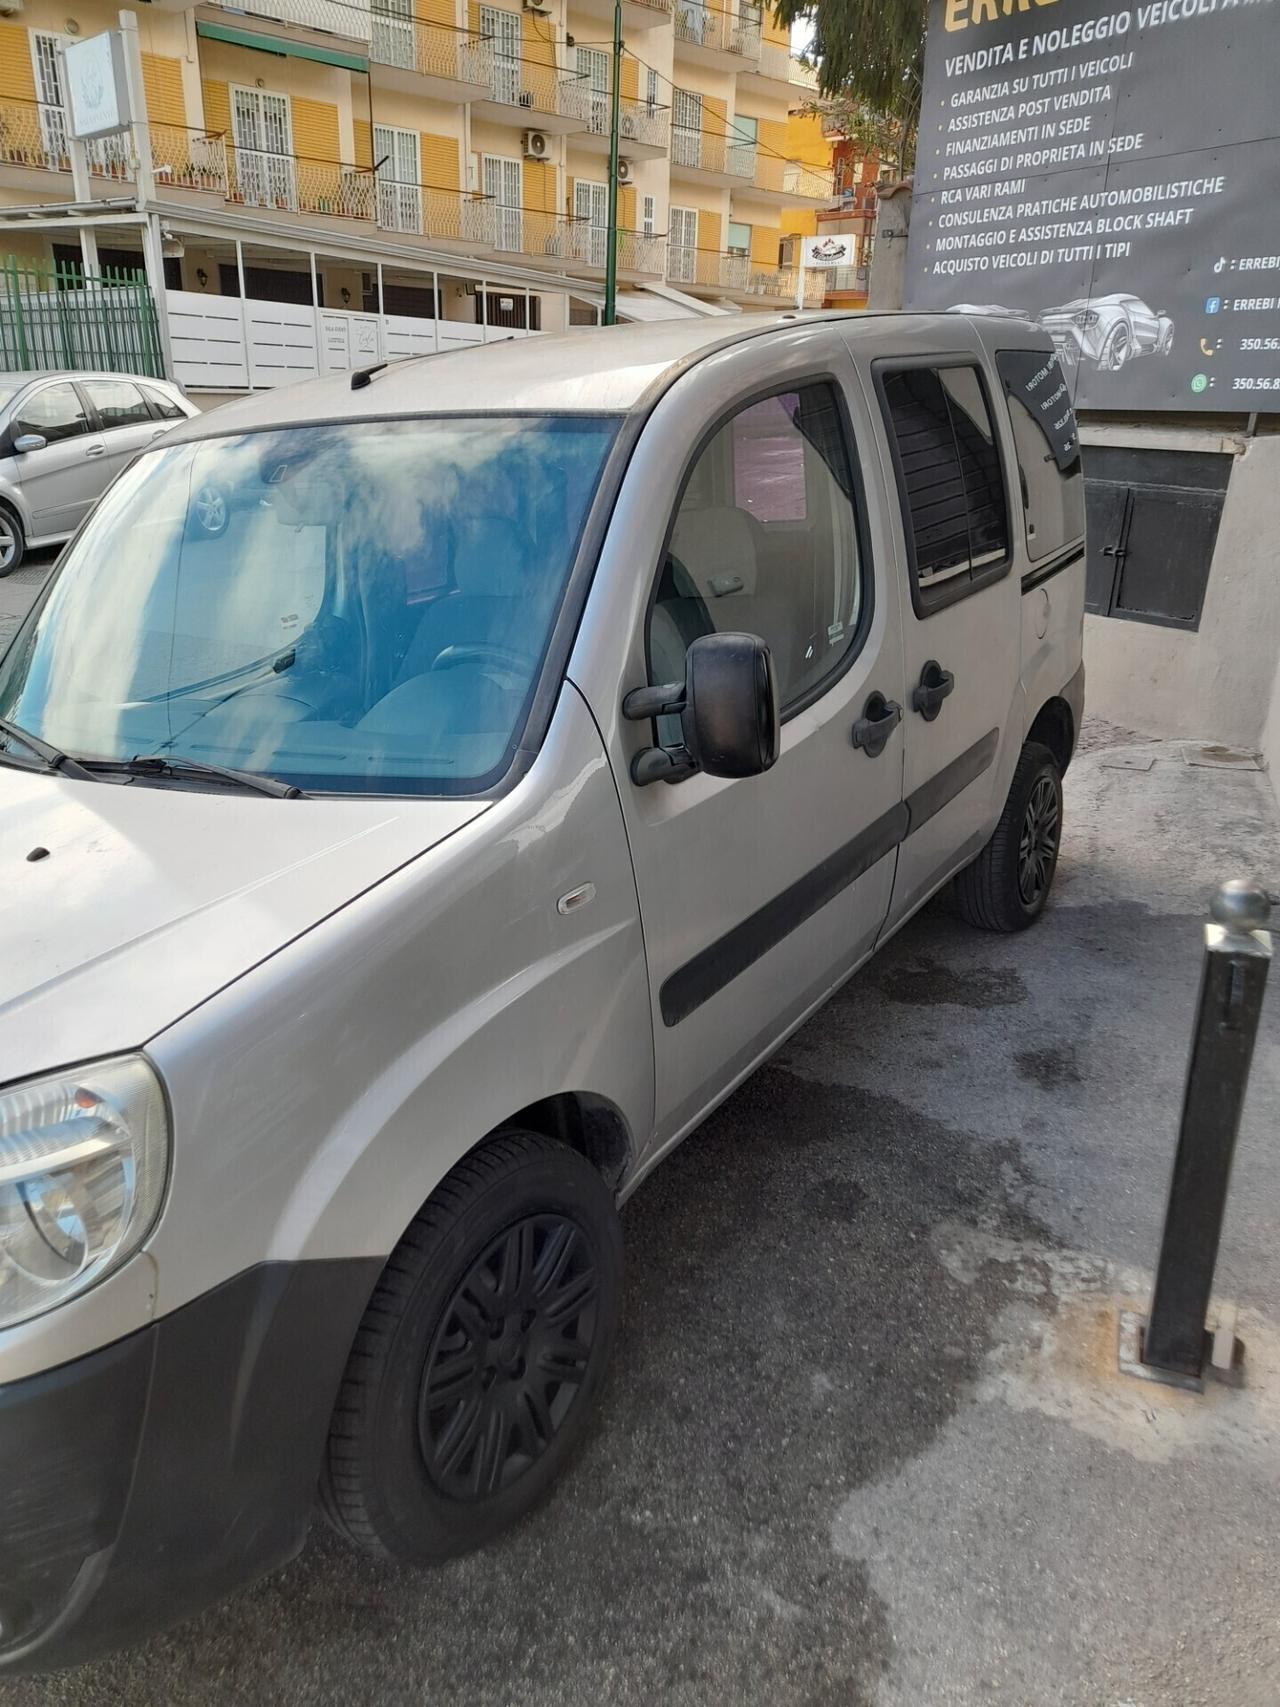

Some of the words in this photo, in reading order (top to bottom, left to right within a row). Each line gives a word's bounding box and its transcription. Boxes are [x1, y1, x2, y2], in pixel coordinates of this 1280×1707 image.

[945, 43, 1014, 77] VENDITA
[1018, 38, 1029, 59] E
[1032, 11, 1131, 56] NOLEGGIO
[950, 81, 1009, 108] GARANZIA
[1012, 76, 1029, 94] SU
[1032, 67, 1069, 90] TUTTI
[1071, 65, 1077, 81] I
[1079, 52, 1134, 78] VEICOLI
[947, 106, 1015, 132] ASSISTENZA
[1018, 97, 1051, 118] POST
[1054, 85, 1111, 110] VENDITA
[943, 158, 998, 181] PASSAGGI
[1000, 156, 1014, 171] DI
[1016, 143, 1085, 168] PROPRIETA
[1089, 139, 1105, 156] IN
[1107, 133, 1144, 154] SEDE
[946, 125, 1039, 156] FINANZIAMENTI
[1041, 123, 1056, 139] IN
[1058, 116, 1092, 136] SEDE
[938, 205, 1013, 228] CONSULENZA
[1016, 196, 1078, 218] PRATICHE
[1079, 176, 1225, 211] AUTOMOBILISTICHE
[940, 189, 962, 205] RCA
[965, 184, 992, 201] VARI
[994, 178, 1026, 197] RAMI
[935, 230, 1006, 252] MONTAGGIO
[1009, 229, 1017, 243] E
[1018, 220, 1093, 243] ASSISTENZA
[1096, 214, 1144, 234] BLOCK
[1145, 208, 1194, 228] SHAFT
[932, 256, 989, 275] ACQUISTO
[991, 251, 1037, 269] VEICOLI
[1040, 249, 1055, 264] DI
[1057, 245, 1094, 263] TUTTI
[1096, 244, 1101, 259] I
[1105, 242, 1131, 258] TIPI
[1239, 256, 1280, 271] ERREBI
[1233, 298, 1275, 311] ERREBI
